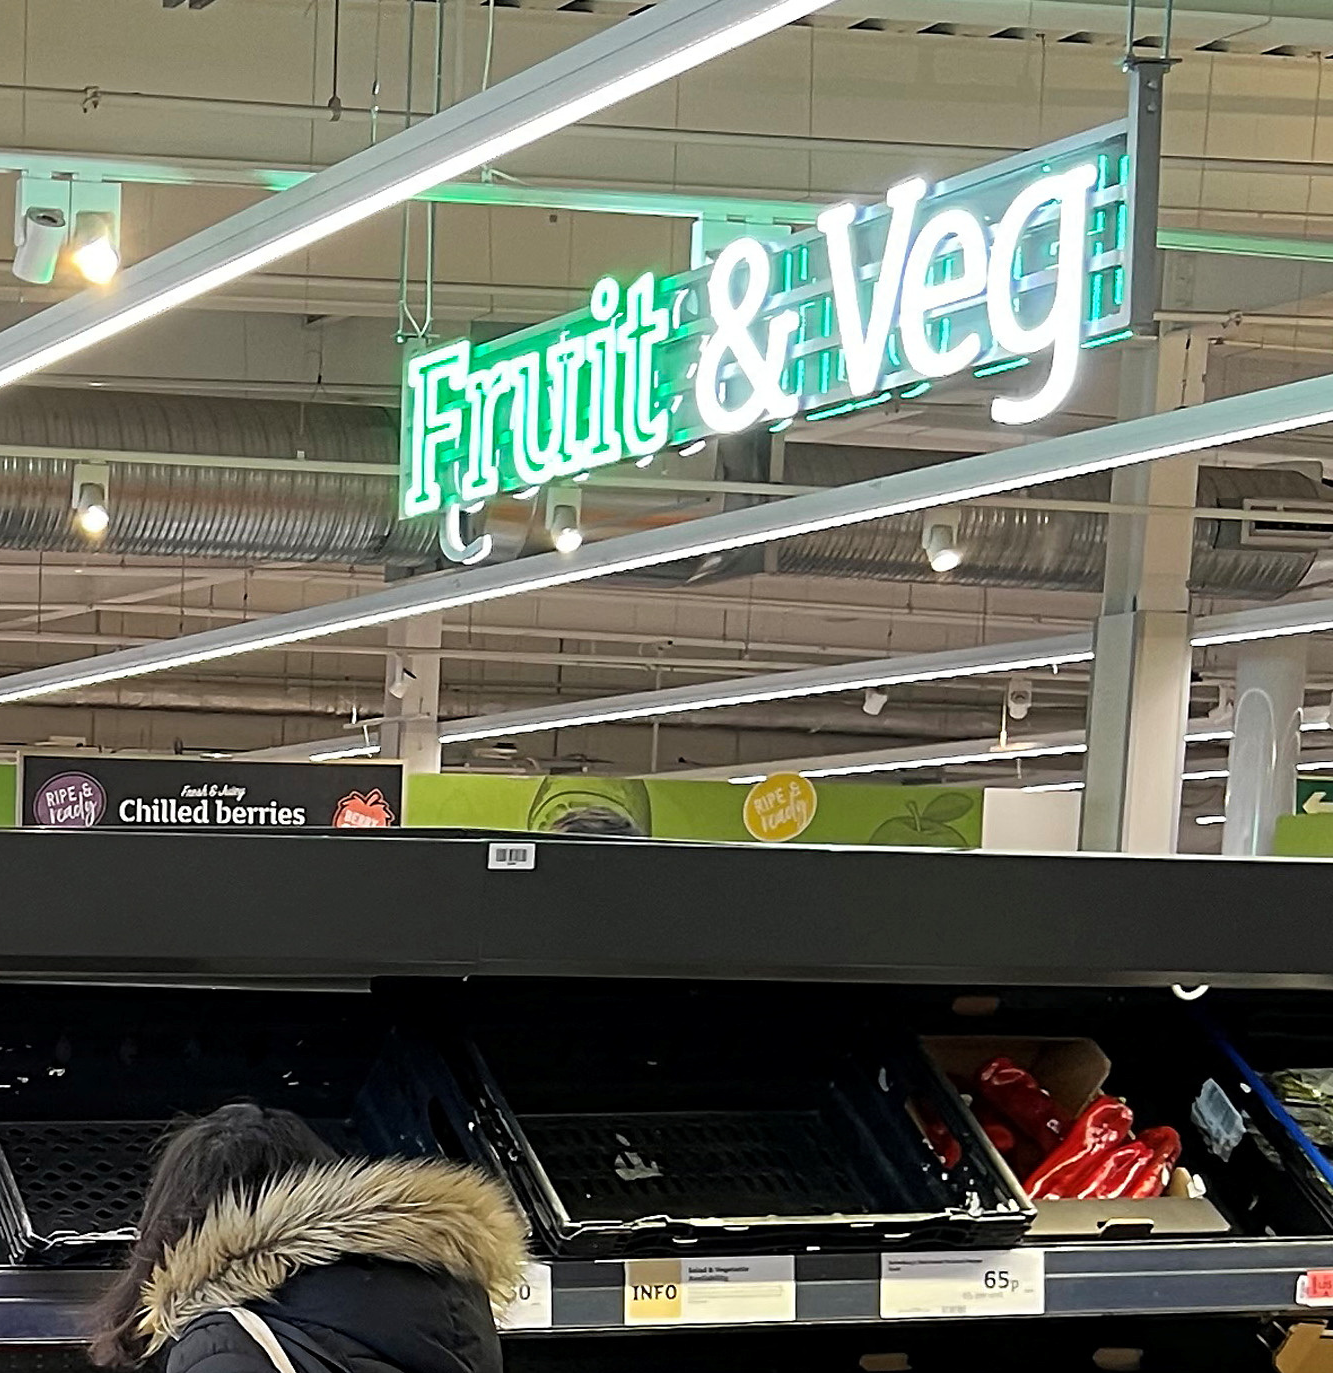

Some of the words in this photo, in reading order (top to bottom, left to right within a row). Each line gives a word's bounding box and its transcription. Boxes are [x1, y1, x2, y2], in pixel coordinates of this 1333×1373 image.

[405, 271, 673, 517] Fruit
[695, 237, 801, 436] &
[818, 171, 1099, 425] Veg
[45, 786, 77, 807] RIPE
[82, 782, 93, 797] &
[49, 792, 98, 826] ready
[753, 787, 787, 816] RIPE
[118, 797, 210, 825] Chilled
[215, 800, 306, 826] berries
[633, 1284, 678, 1301] INFO
[984, 1270, 1020, 1292] 65p
